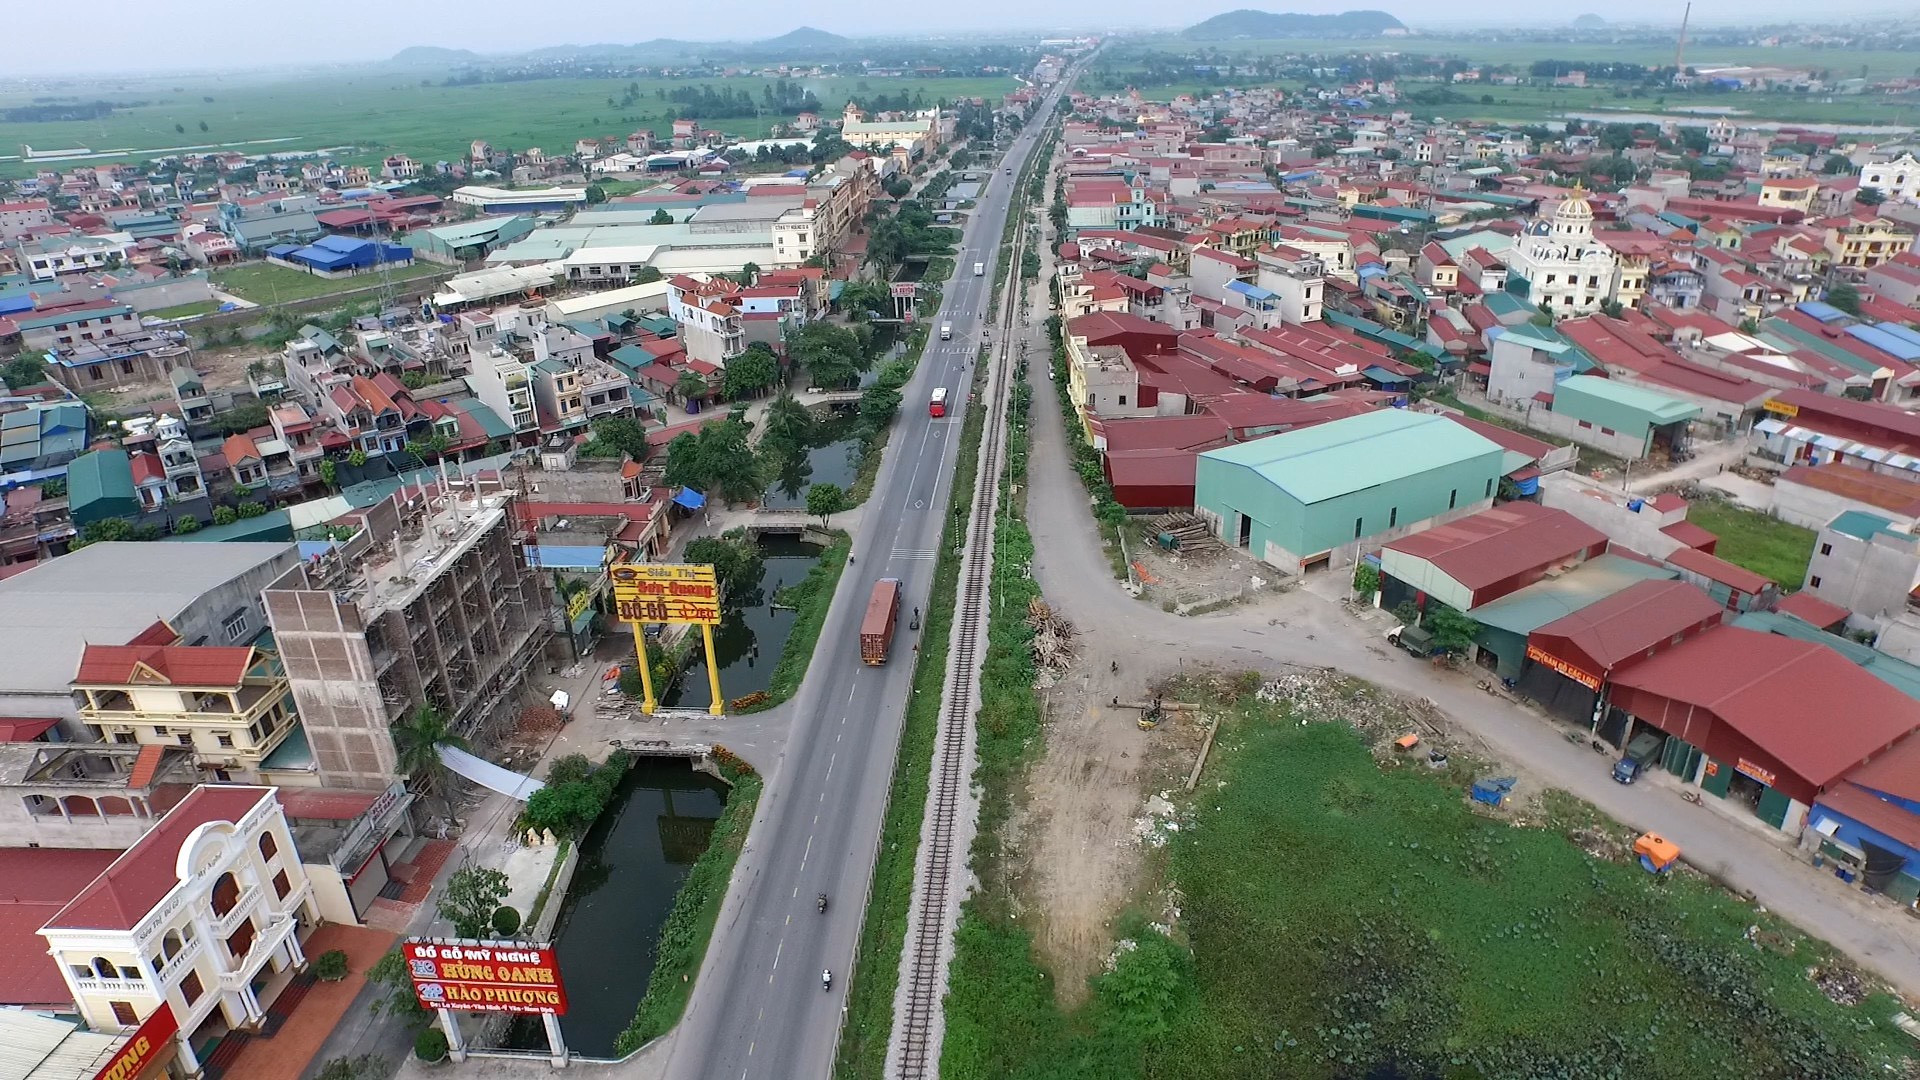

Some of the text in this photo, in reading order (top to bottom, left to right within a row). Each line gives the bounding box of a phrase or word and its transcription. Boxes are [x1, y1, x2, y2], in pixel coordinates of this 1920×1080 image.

[647, 568, 695, 580] Siêu Thị
[414, 945, 437, 958] ĐỒ
[441, 946, 463, 960] GỖ
[495, 951, 541, 965] NGHỆ
[498, 966, 555, 984] OANH
